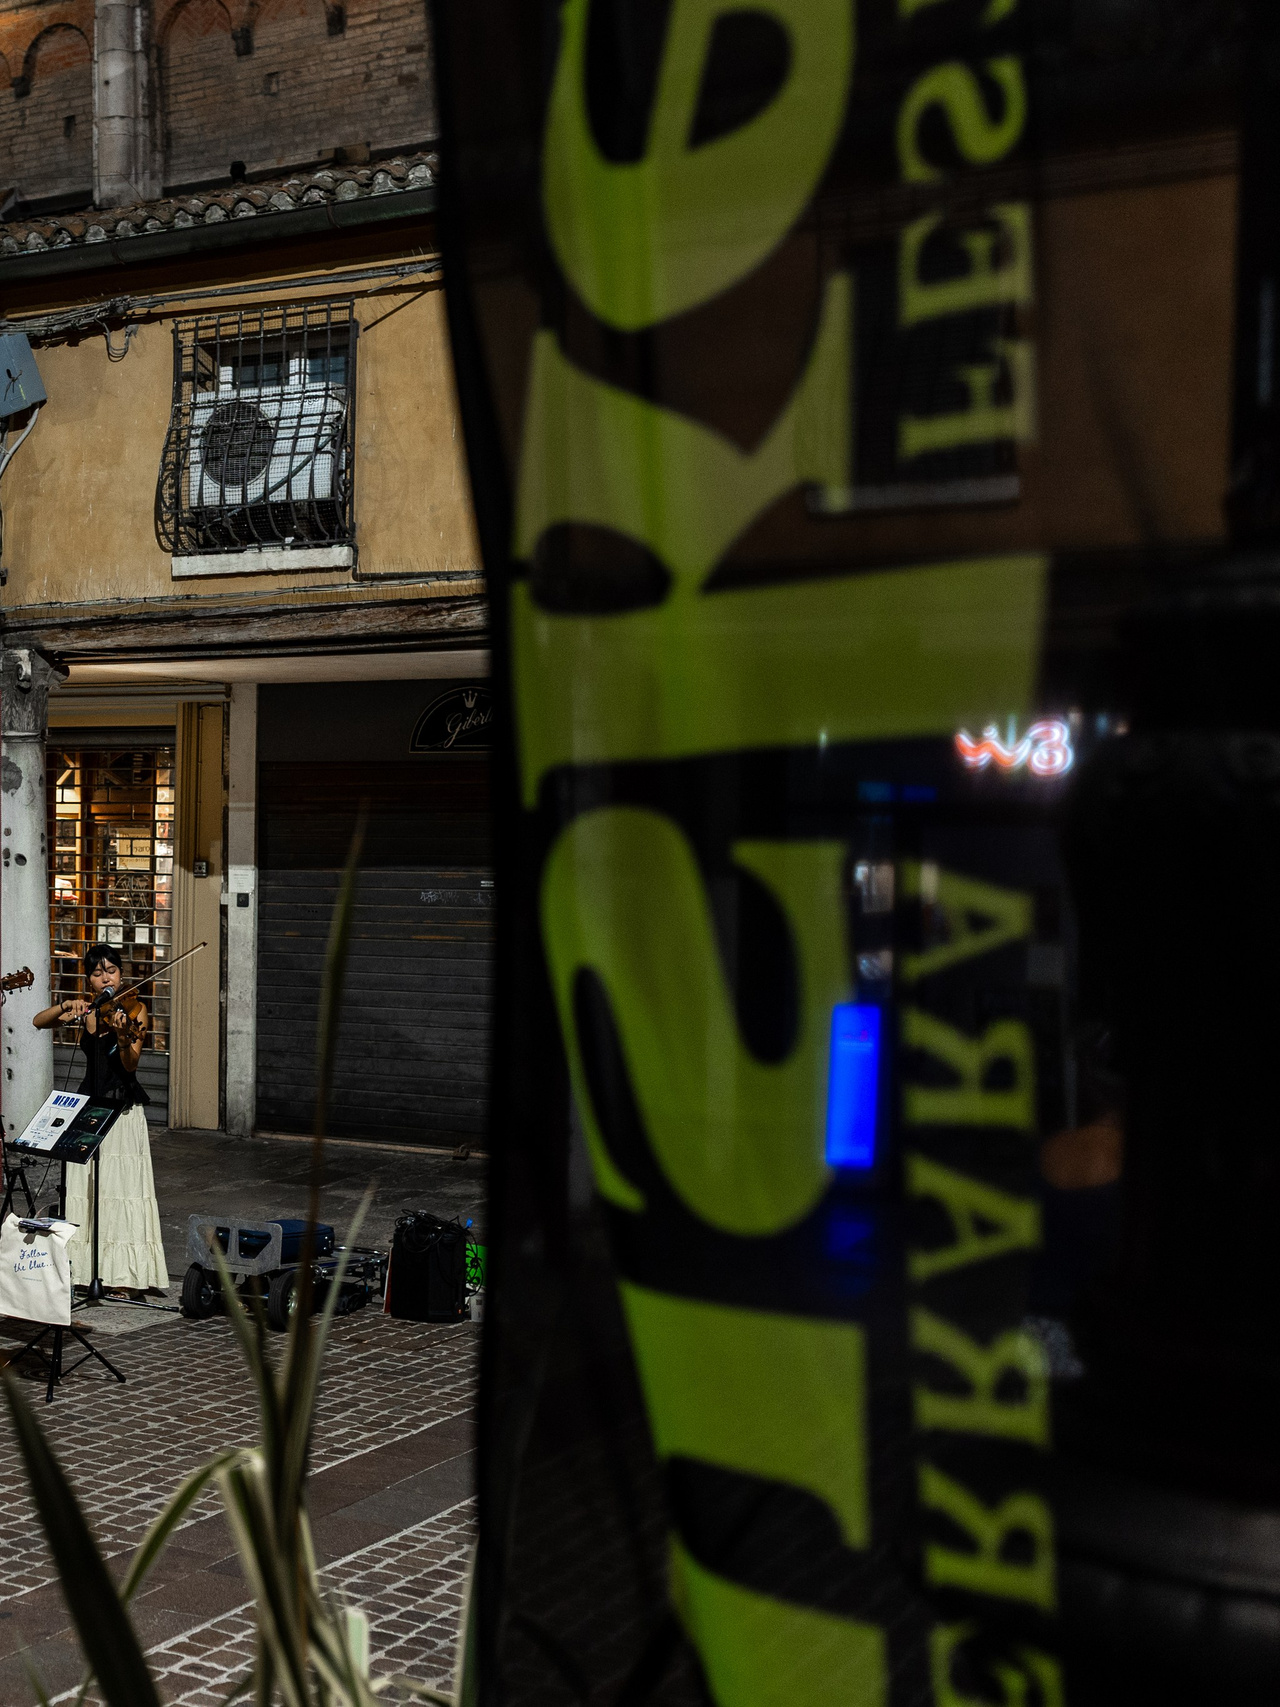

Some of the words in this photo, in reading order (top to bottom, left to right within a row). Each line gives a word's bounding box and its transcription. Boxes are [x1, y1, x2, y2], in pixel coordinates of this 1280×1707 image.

[52, 1095, 80, 1108] MERCH
[20, 1249, 48, 1260] Follow
[14, 1263, 26, 1273] the
